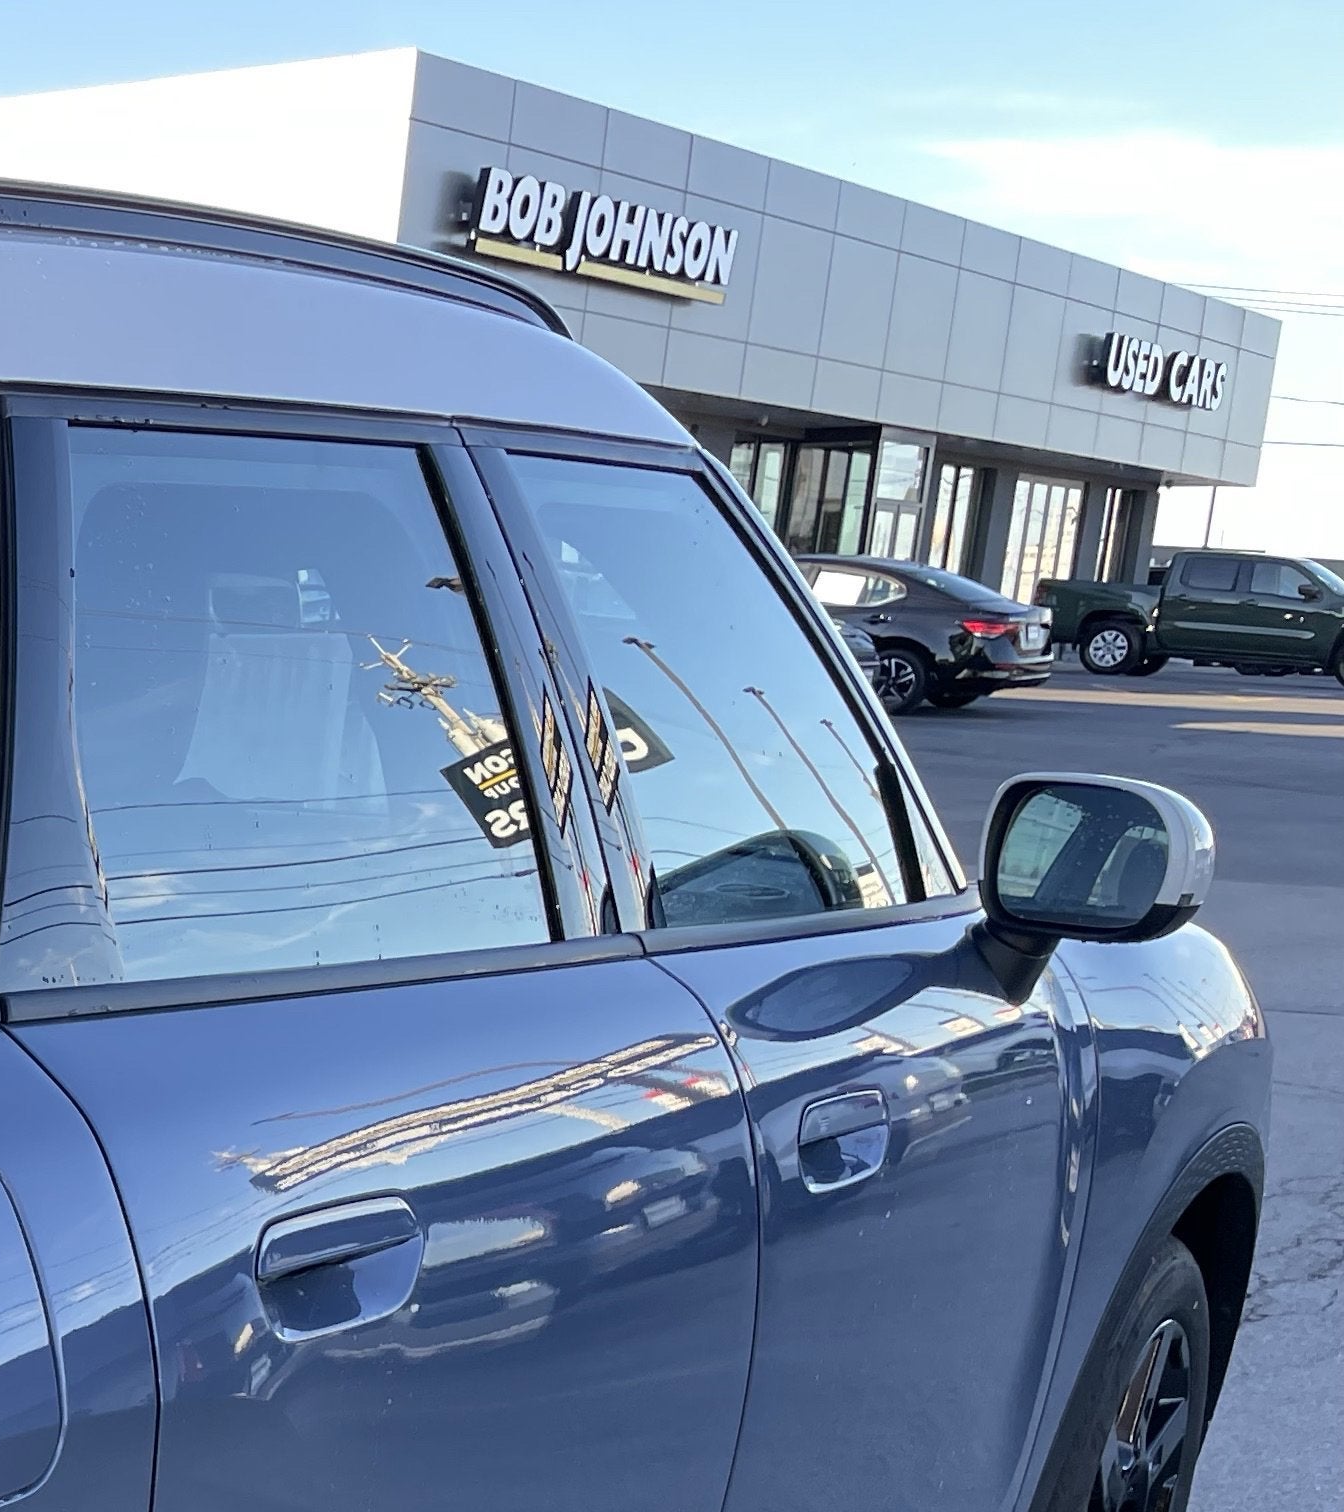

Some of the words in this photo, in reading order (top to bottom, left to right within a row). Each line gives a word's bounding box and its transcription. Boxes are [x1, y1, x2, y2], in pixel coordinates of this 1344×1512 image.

[478, 167, 566, 246] BOB
[566, 191, 739, 285] JOHNSON
[1107, 332, 1163, 395] USED
[1169, 351, 1228, 411] CARS
